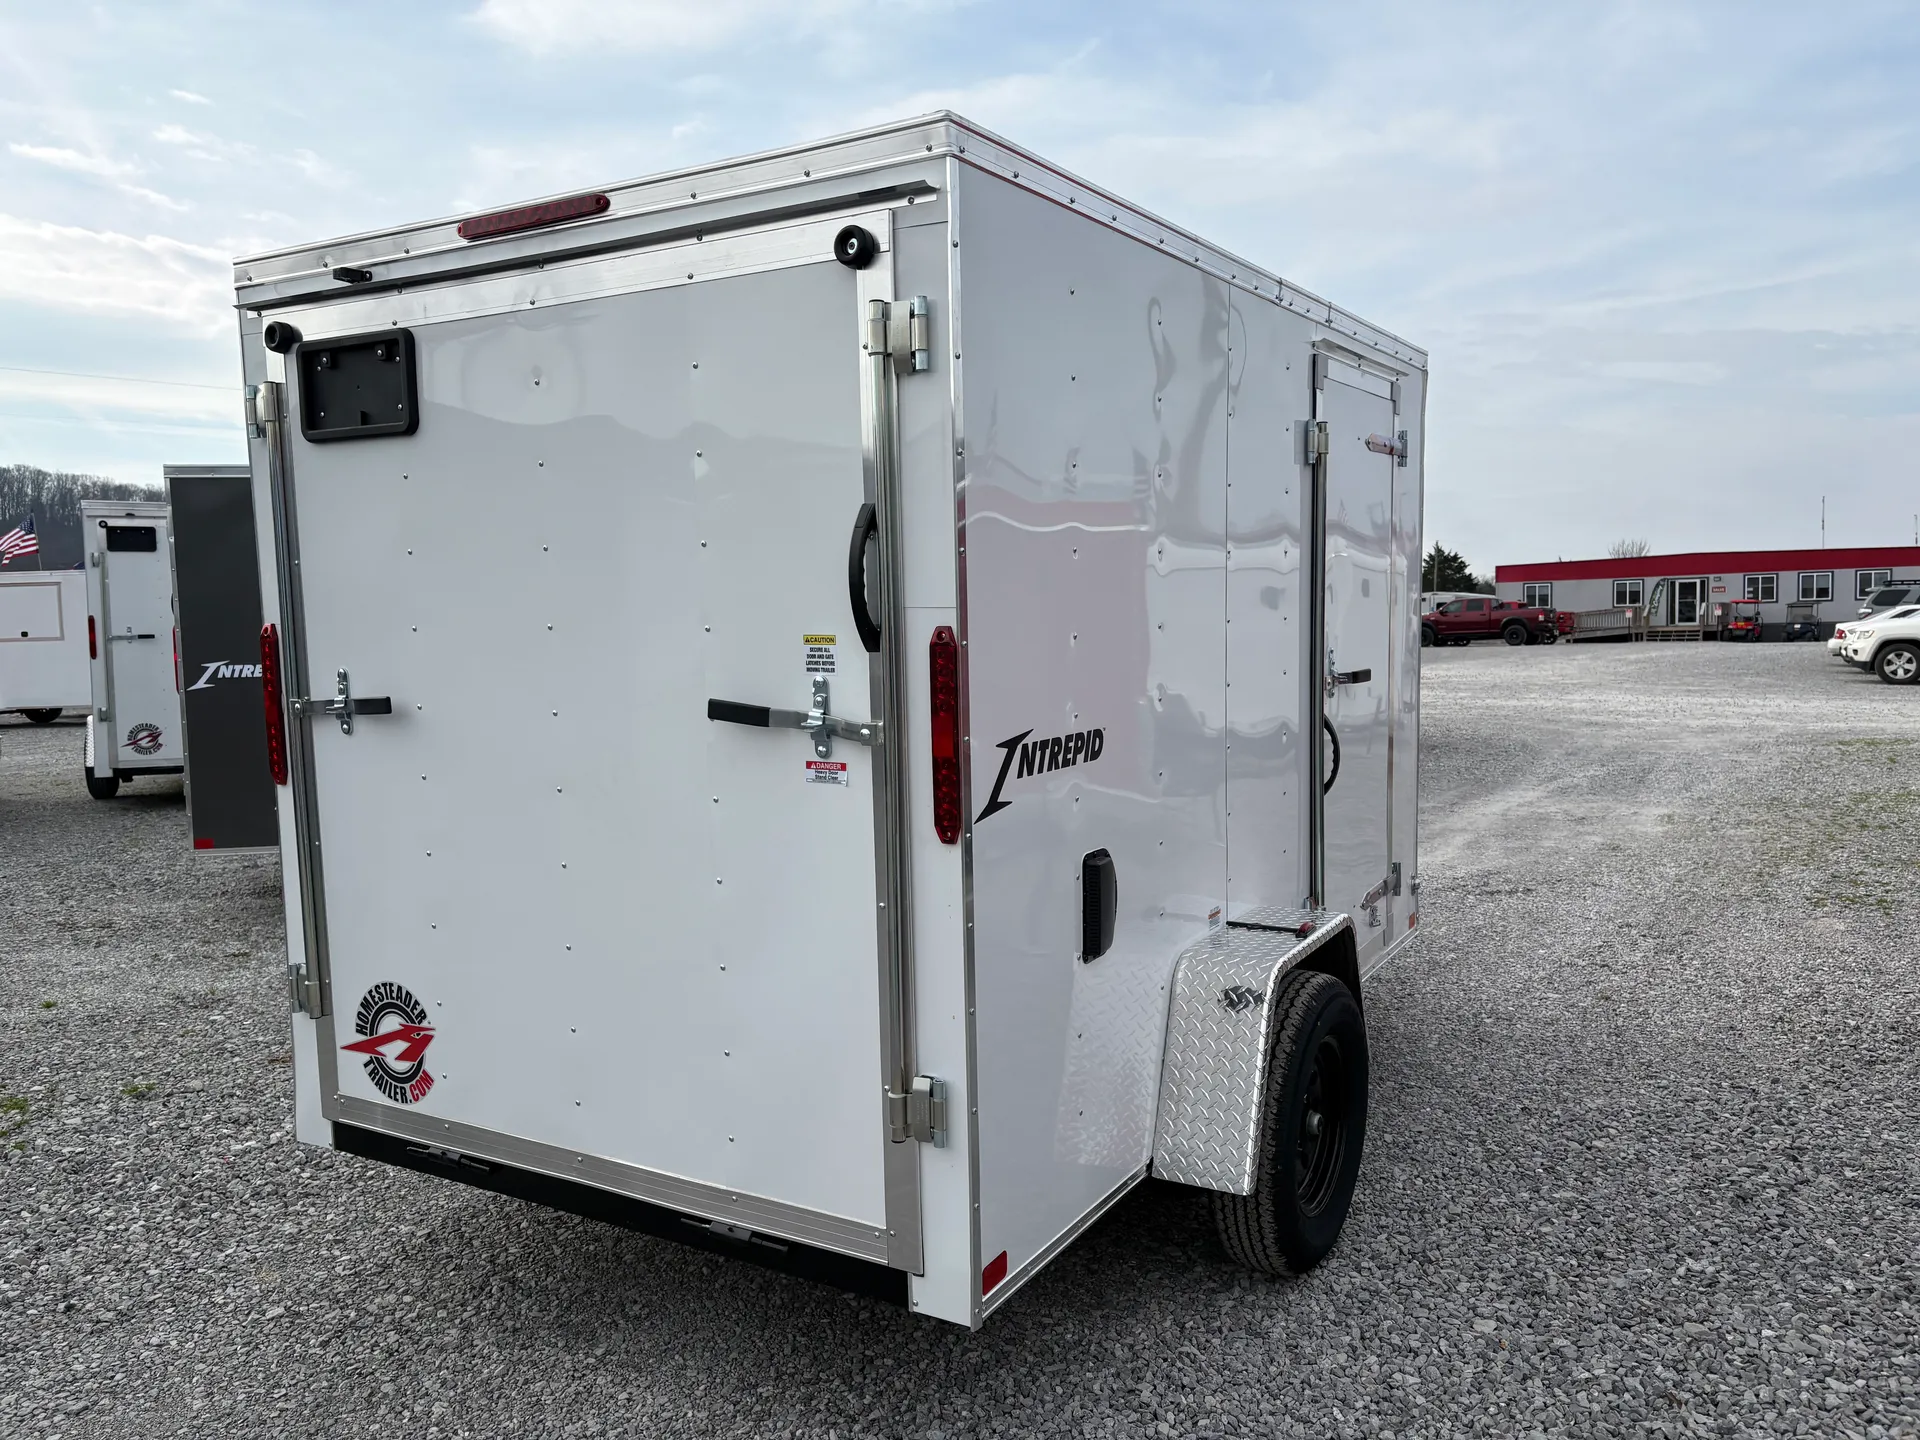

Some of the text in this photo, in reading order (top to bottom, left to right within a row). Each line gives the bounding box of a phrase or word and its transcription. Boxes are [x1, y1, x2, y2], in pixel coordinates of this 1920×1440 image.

[816, 762, 842, 770] DANGER
[973, 728, 1104, 825] INTREPID
[355, 982, 428, 1038] HOMESTEADER
[363, 1055, 435, 1105] TRAILER.COM
